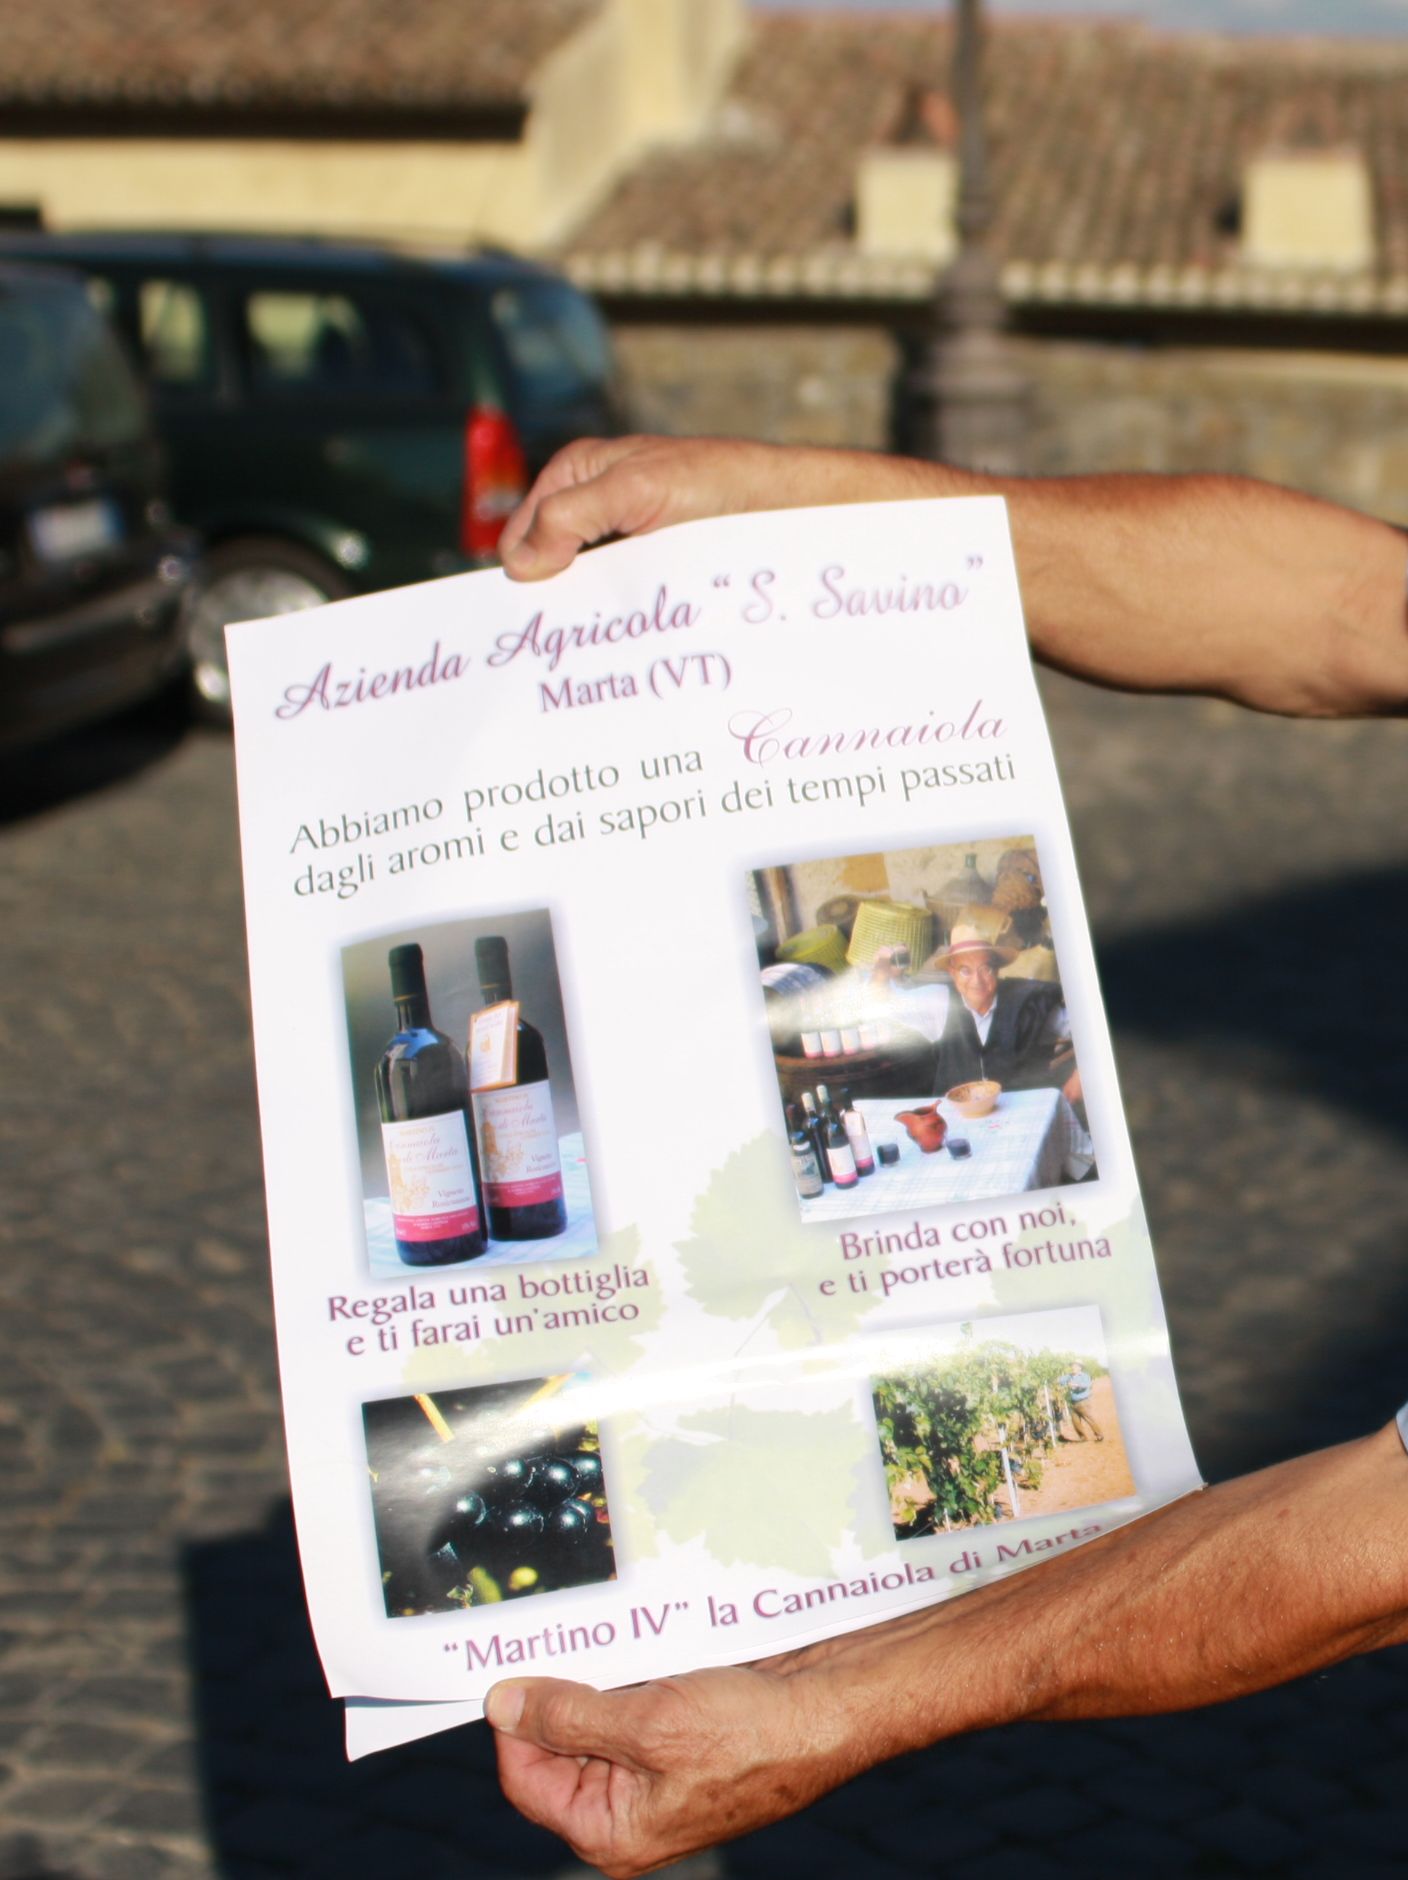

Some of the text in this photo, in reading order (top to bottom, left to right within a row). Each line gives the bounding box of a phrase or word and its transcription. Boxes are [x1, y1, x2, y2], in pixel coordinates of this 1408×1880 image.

[275, 640, 470, 721] Azienda
[486, 584, 699, 671] Agricola
[539, 653, 732, 713] Marta (VT)
[290, 699, 1006, 853] Abbiamo prodotto una Cannaiola
[293, 753, 1016, 900] dagli aromi e dai sapori dei tempi passati
[840, 1202, 1076, 1261] Brinda con noi,
[327, 1263, 650, 1327] Regala una bottiglia
[819, 1236, 1112, 1297] e ti porterà fortuna
[346, 1333, 365, 1356] e
[377, 1325, 398, 1352] ti
[411, 1314, 481, 1348] farai
[444, 1523, 1103, 1672] “Martino IV” la Cannaiola di Marta
